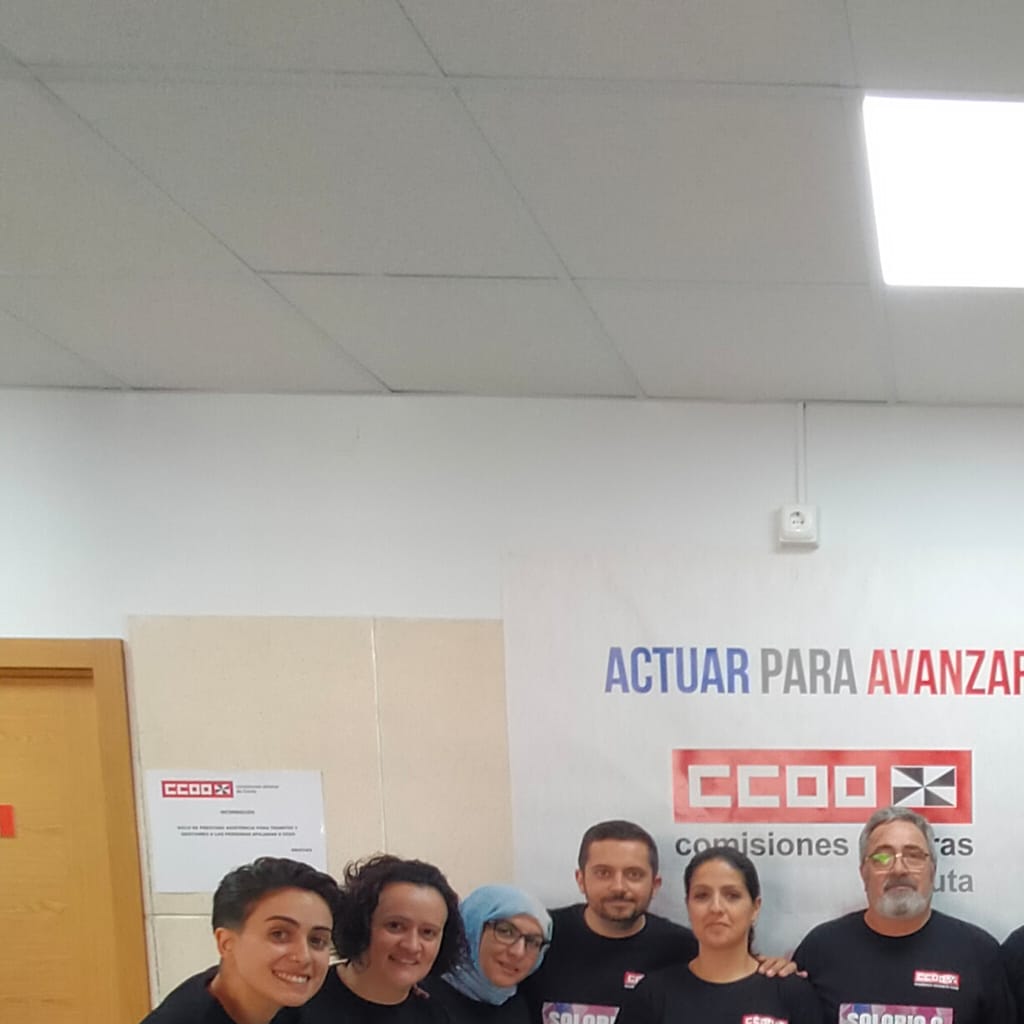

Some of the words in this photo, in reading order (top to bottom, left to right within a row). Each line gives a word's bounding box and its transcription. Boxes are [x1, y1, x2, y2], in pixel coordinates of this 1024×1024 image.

[604, 646, 750, 694] ACTUAR
[760, 648, 858, 694] PARA
[164, 783, 213, 795] CCOO
[688, 764, 877, 808] CCOO
[675, 832, 850, 857] comisiones
[932, 869, 974, 892] uta
